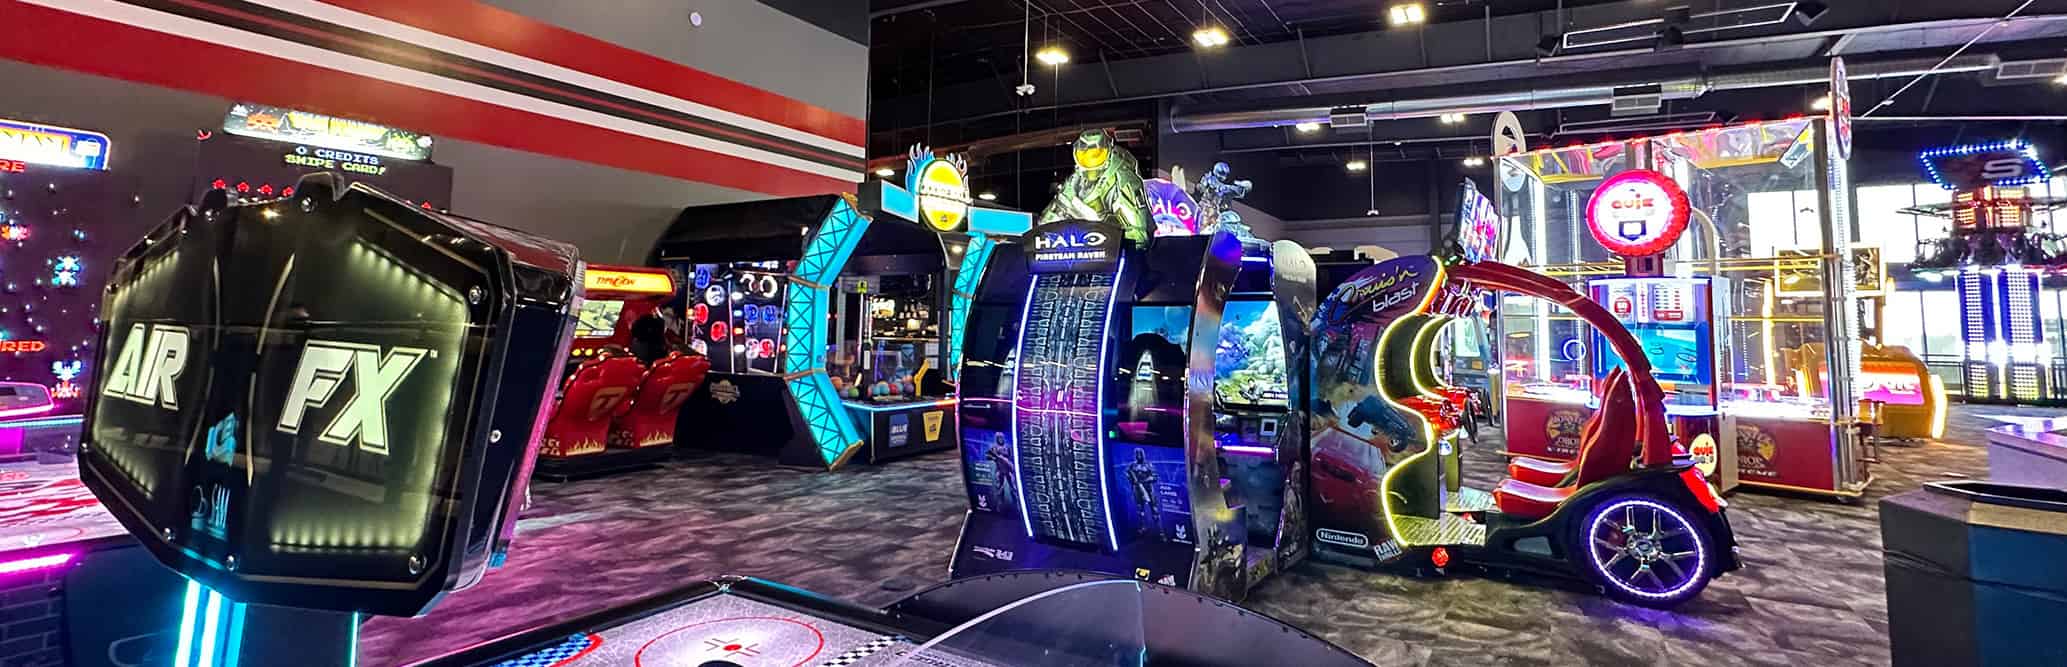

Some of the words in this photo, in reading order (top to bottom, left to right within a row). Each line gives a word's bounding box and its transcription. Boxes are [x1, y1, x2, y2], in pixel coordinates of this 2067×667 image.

[285, 154, 335, 169] SWIPE
[342, 162, 386, 175] CARD!
[314, 149, 379, 164] CREDITS
[1147, 197, 1193, 220] ALO
[1034, 231, 1107, 250] HALO
[1034, 252, 1075, 261] FIRETEAM
[0, 340, 46, 353] RED
[103, 322, 190, 411] AIR
[276, 339, 429, 456] FX
[1319, 531, 1364, 545] Nintendo
